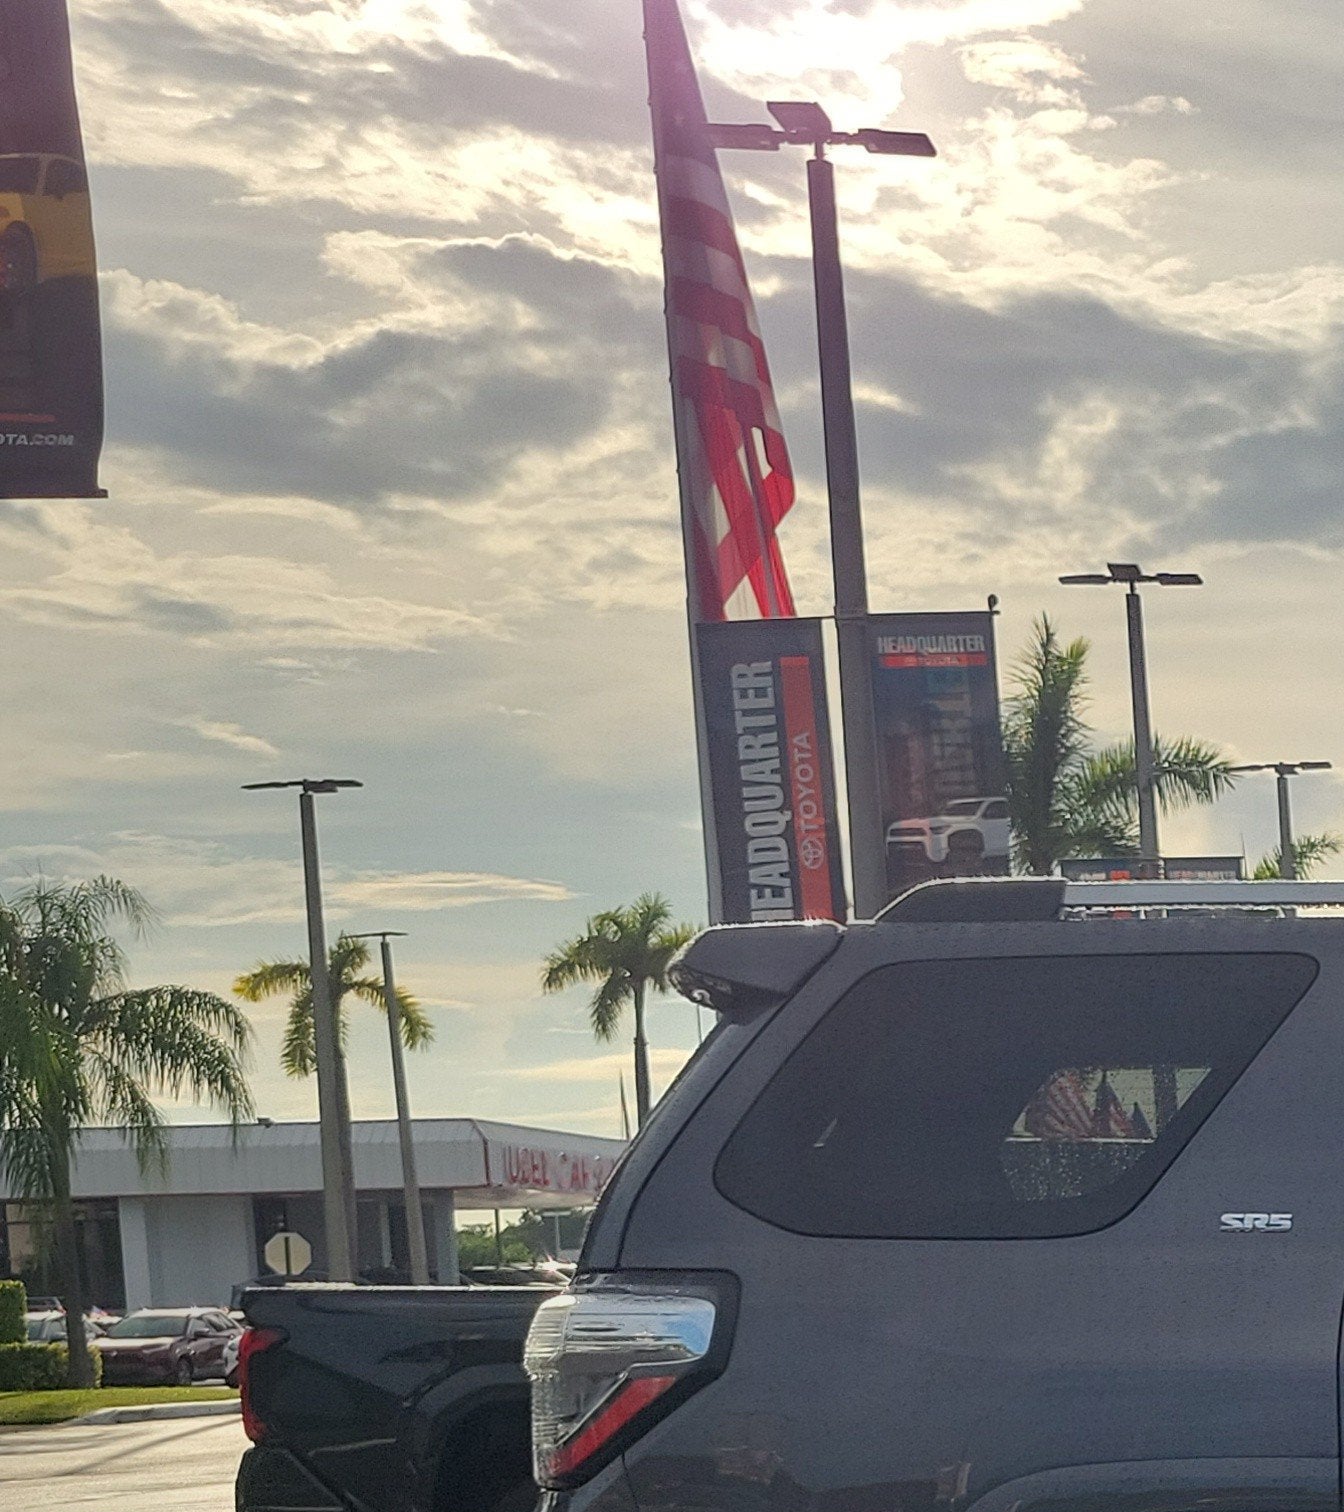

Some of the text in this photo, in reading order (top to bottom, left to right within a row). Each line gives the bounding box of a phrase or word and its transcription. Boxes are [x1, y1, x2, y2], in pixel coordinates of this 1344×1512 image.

[877, 634, 986, 655] HEADQUARTER
[793, 731, 819, 834] TOYOTA
[1219, 1212, 1293, 1233] SR5
